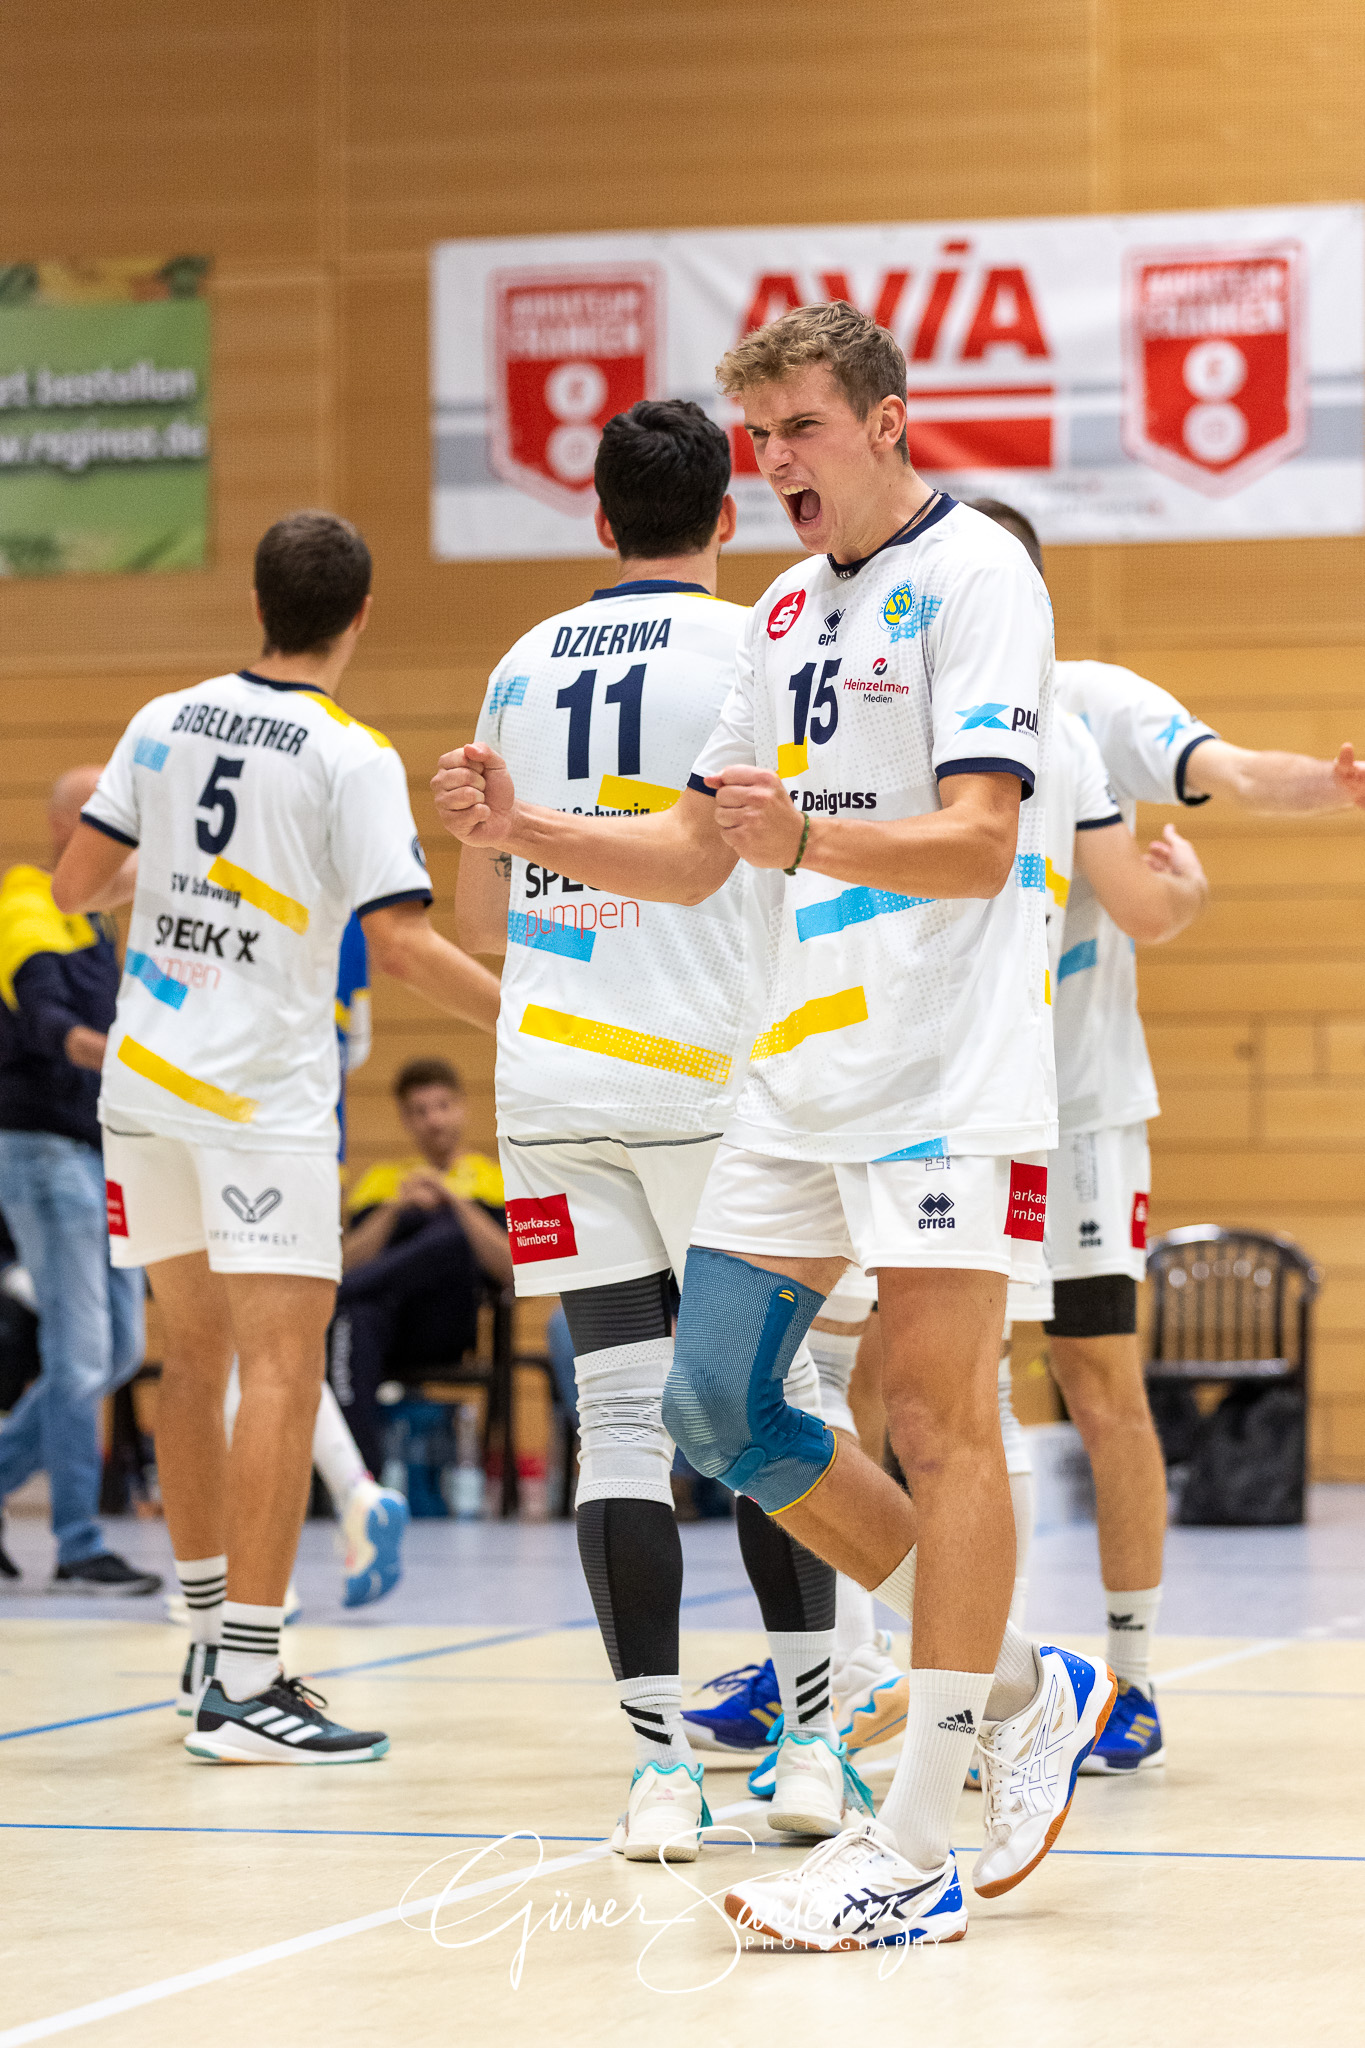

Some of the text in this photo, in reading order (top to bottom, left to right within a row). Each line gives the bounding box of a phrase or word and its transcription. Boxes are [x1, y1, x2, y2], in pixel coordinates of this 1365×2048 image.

[551, 617, 672, 658] DZIERWA
[788, 657, 843, 745] 15
[863, 693, 893, 704] Medien
[555, 663, 648, 780] 11
[195, 755, 245, 856] 5
[524, 900, 640, 946] pumpen
[513, 1217, 561, 1233] Sparkasse
[918, 1217, 956, 1230] errea
[516, 1233, 559, 1248] Nürnberg
[937, 1721, 977, 1735] adidas
